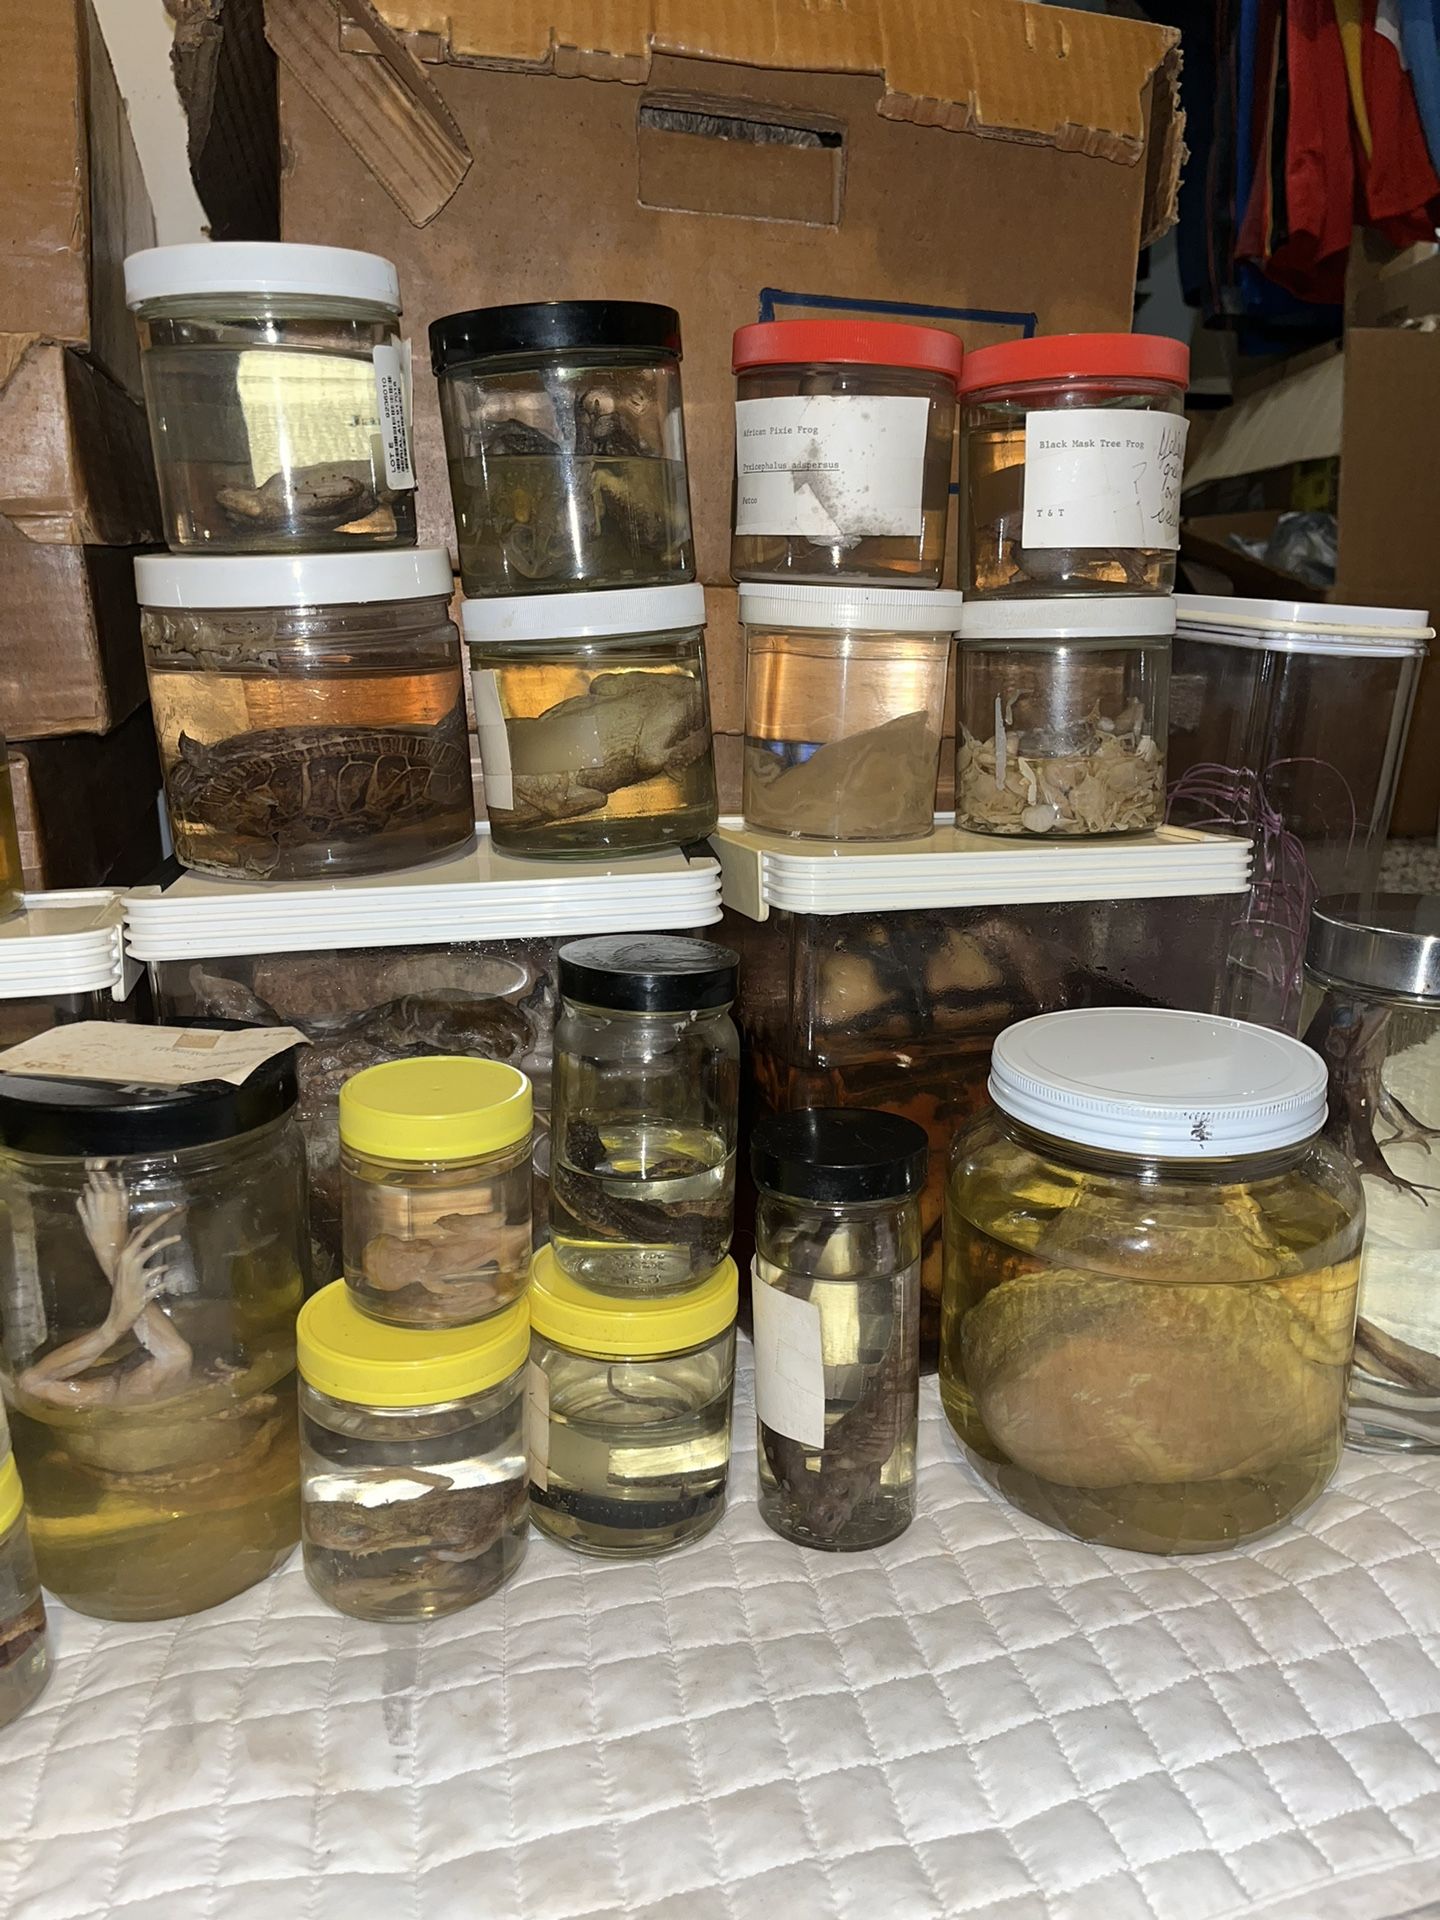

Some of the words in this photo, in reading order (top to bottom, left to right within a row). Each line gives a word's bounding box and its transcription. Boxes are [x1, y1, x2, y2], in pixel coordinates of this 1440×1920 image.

[743, 429, 766, 437] African
[769, 426, 793, 435] Pixie
[797, 425, 819, 436] Frog
[1039, 440, 1067, 449] Black
[1072, 440, 1095, 448] Mask
[1100, 440, 1121, 448] Tree
[1126, 440, 1145, 449] Frog
[388, 452, 396, 473] LOT
[791, 461, 840, 471] adspersus
[1037, 510, 1042, 518] T
[1058, 509, 1065, 517] T
